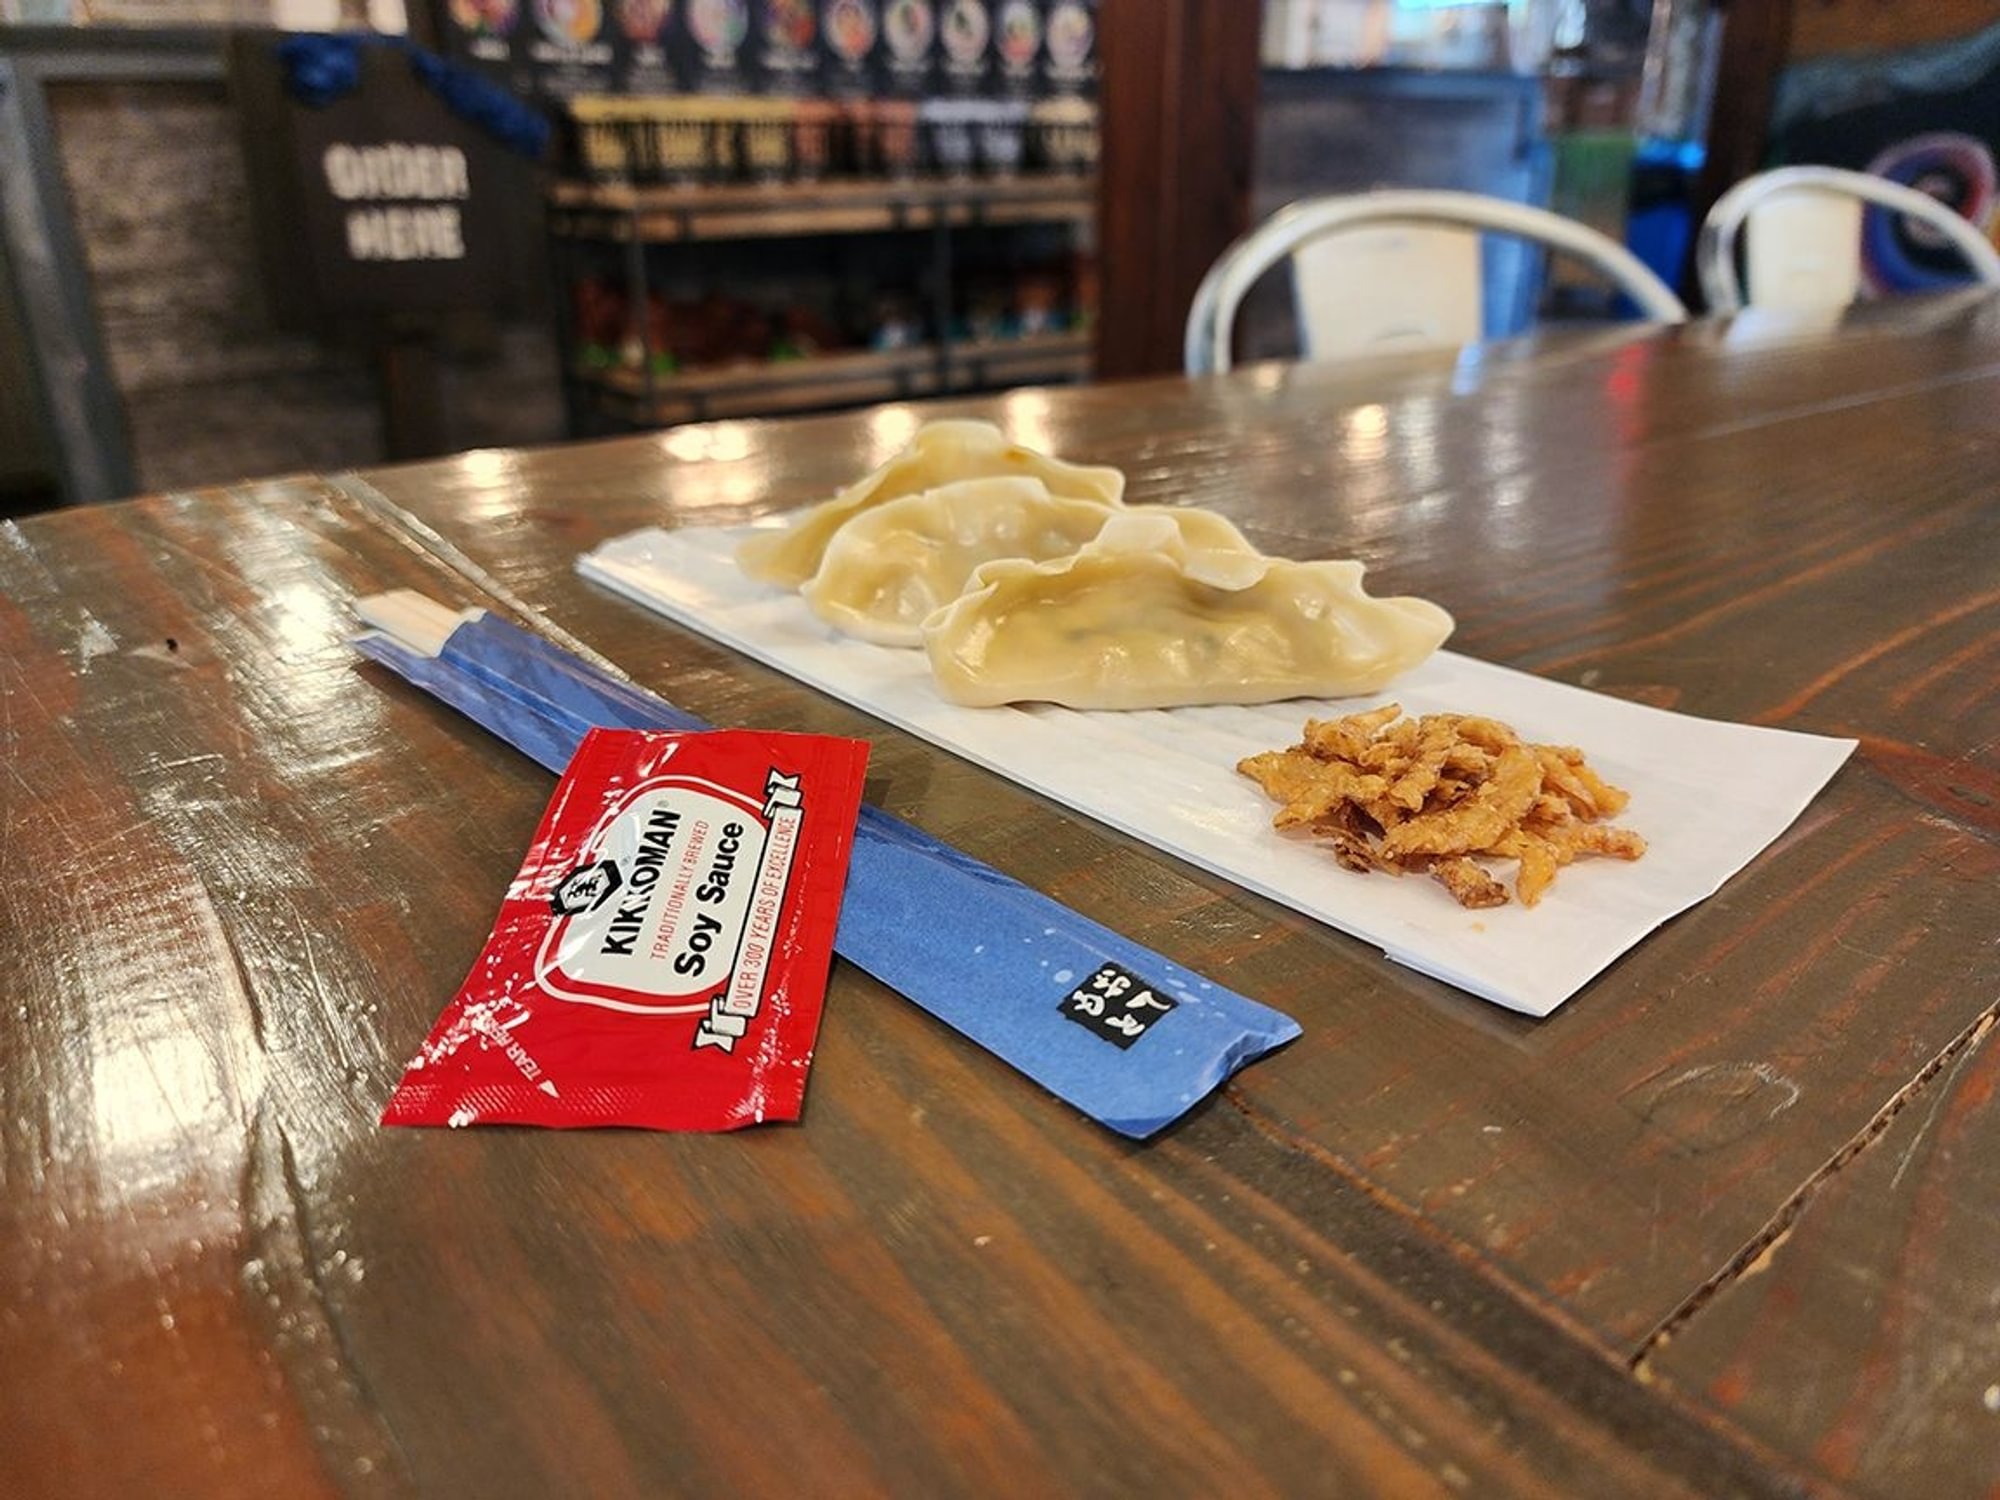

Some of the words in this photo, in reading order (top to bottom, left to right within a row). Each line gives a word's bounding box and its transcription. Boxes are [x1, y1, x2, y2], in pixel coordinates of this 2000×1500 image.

[696, 822, 744, 904] Sauce
[765, 816, 796, 881] EXCELLENCE
[651, 863, 694, 962] TRADITIONALLY
[682, 820, 710, 864] BREWED
[761, 880, 780, 898] OF
[750, 901, 776, 941] YEARS
[674, 913, 722, 977] Soy
[743, 942, 765, 969] 300
[732, 972, 758, 1010] OVER
[505, 1042, 541, 1081] TEAR
